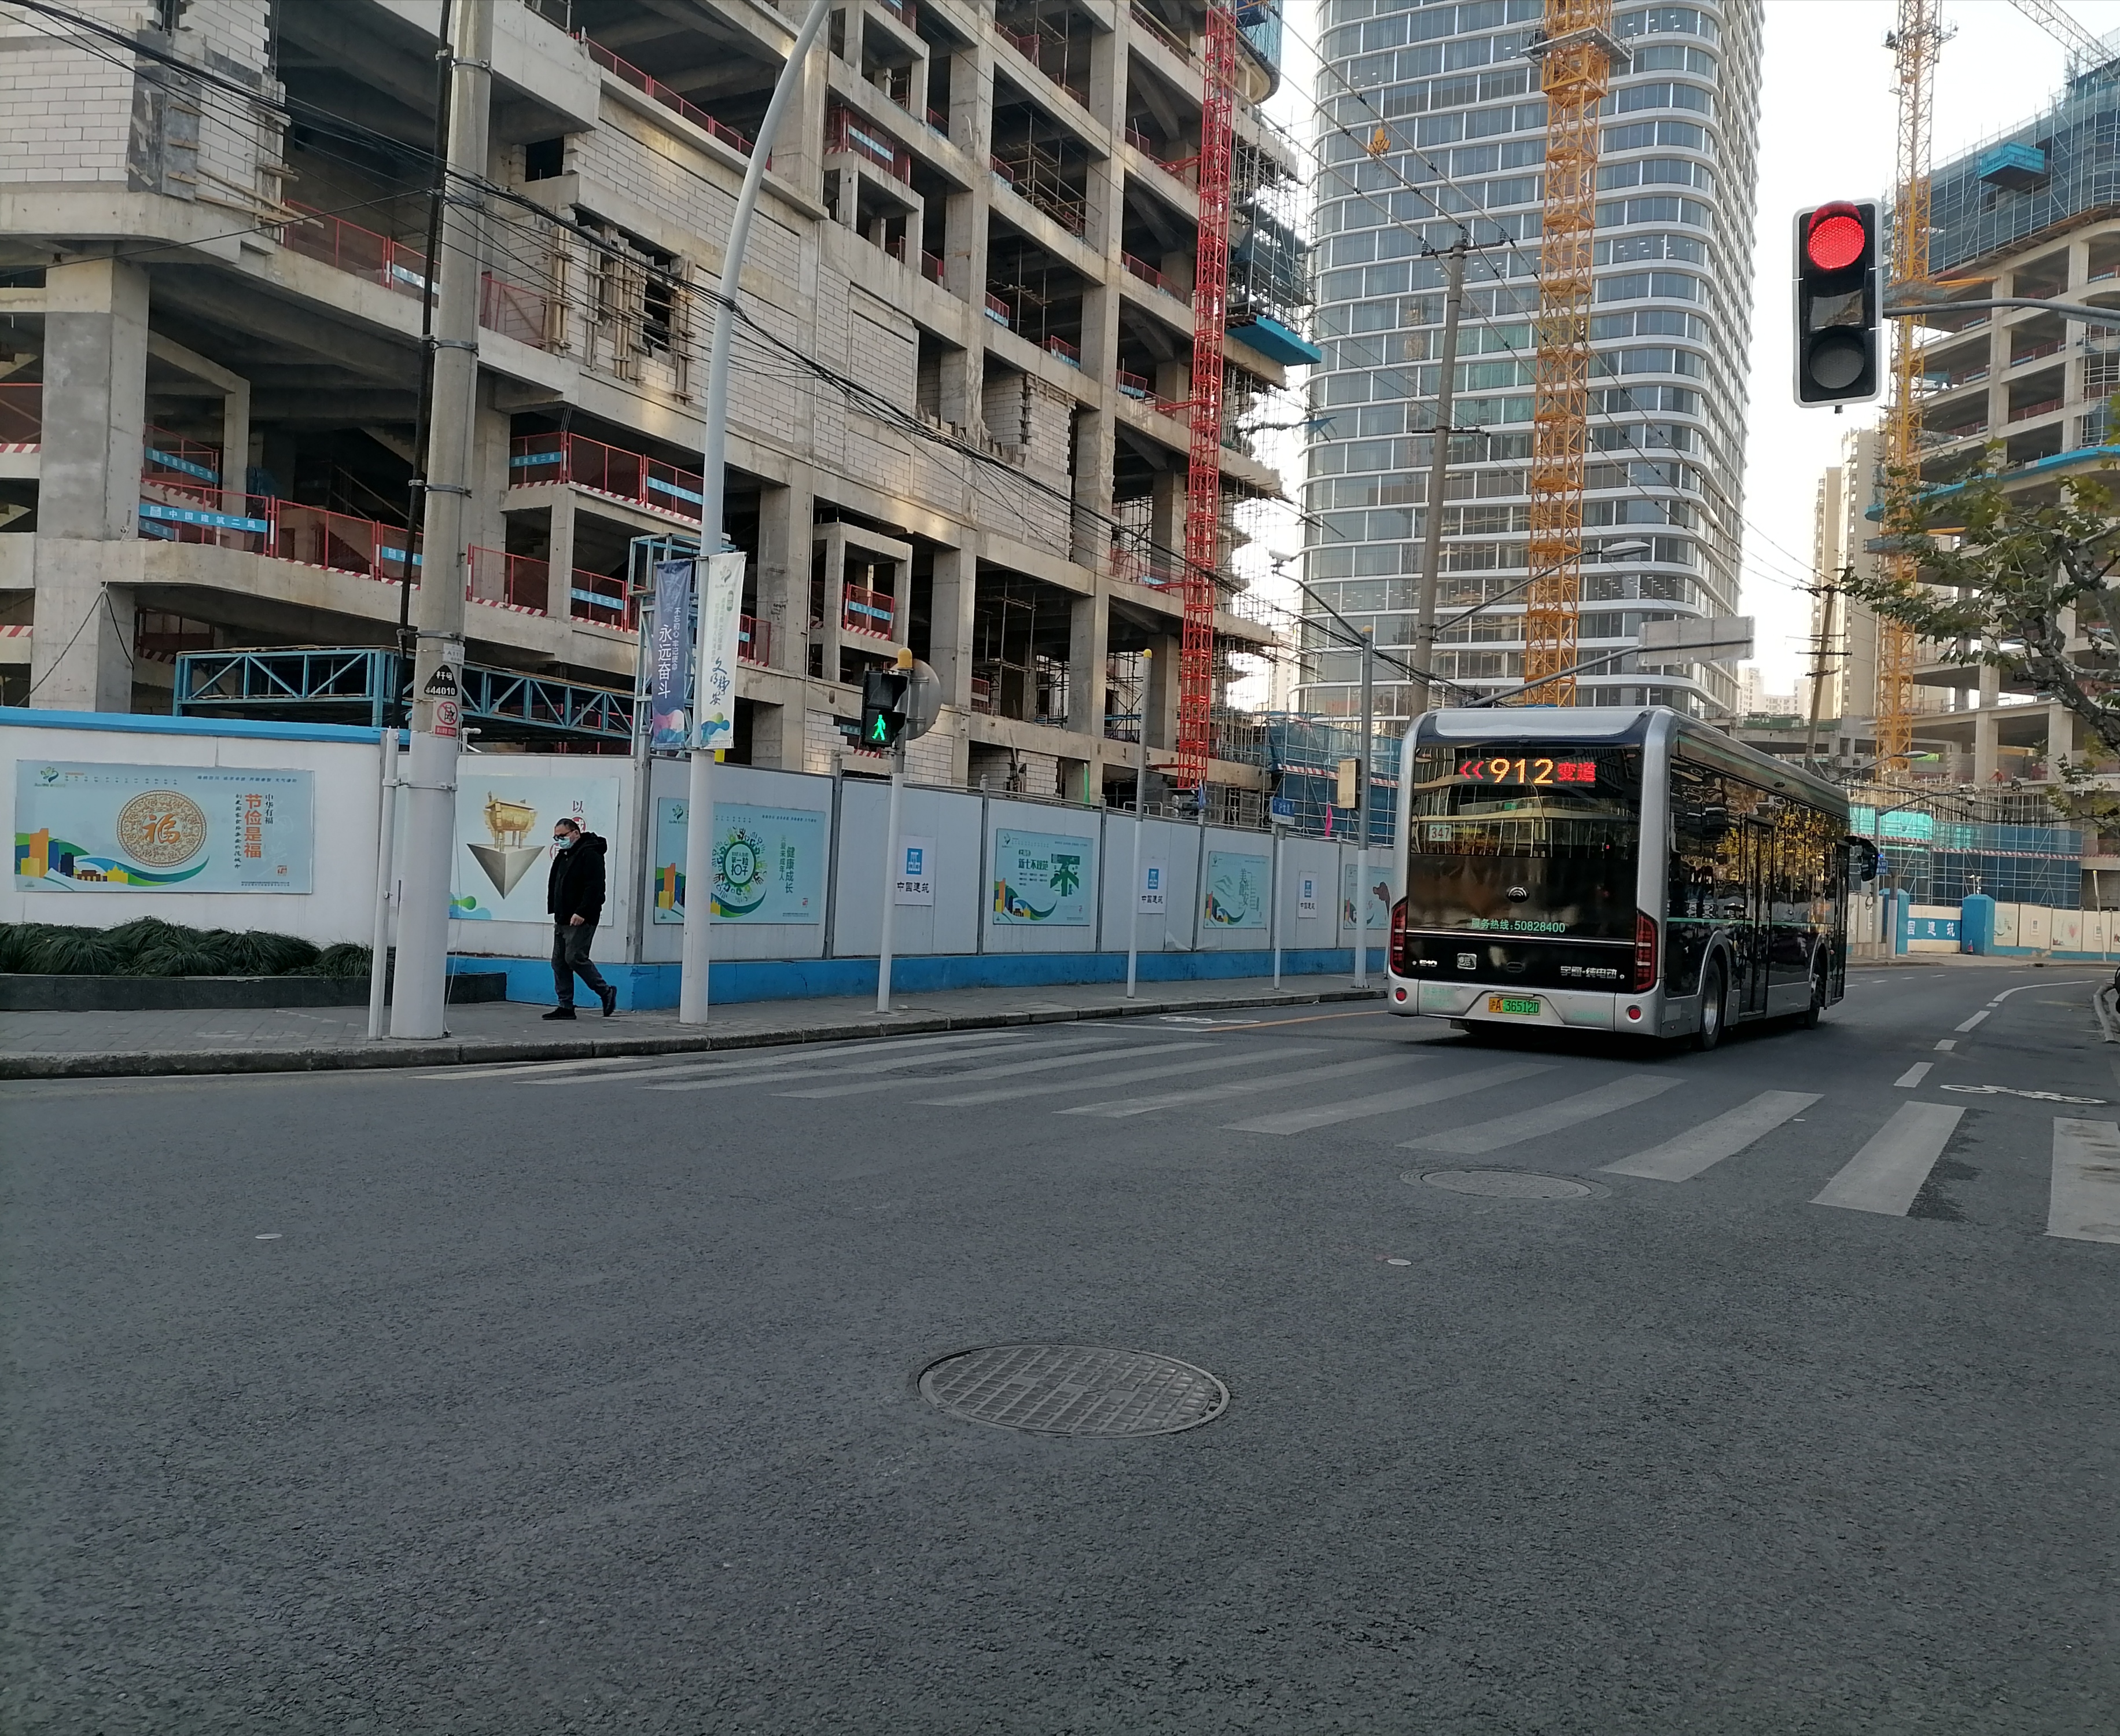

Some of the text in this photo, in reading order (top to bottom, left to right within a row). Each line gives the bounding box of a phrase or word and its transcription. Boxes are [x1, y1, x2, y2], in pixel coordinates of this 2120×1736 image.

[169, 509, 256, 528] 中国建筑二局
[672, 607, 682, 638] 不忘初心
[657, 623, 673, 699] 永远奋斗
[671, 639, 679, 671] 牢记使命
[436, 670, 452, 681] 杆号
[1489, 758, 1597, 784] 912 变道
[265, 793, 274, 824] 中华有福
[572, 800, 584, 814] 以
[142, 813, 180, 845] 福
[244, 793, 263, 859] 节俭是福
[1431, 827, 1450, 839] 347
[785, 847, 796, 893] 健康成长
[897, 881, 929, 893] 中国建筑
[1141, 895, 1163, 904] 中国建筑
[1471, 917, 1566, 933] 服务热线:50828400
